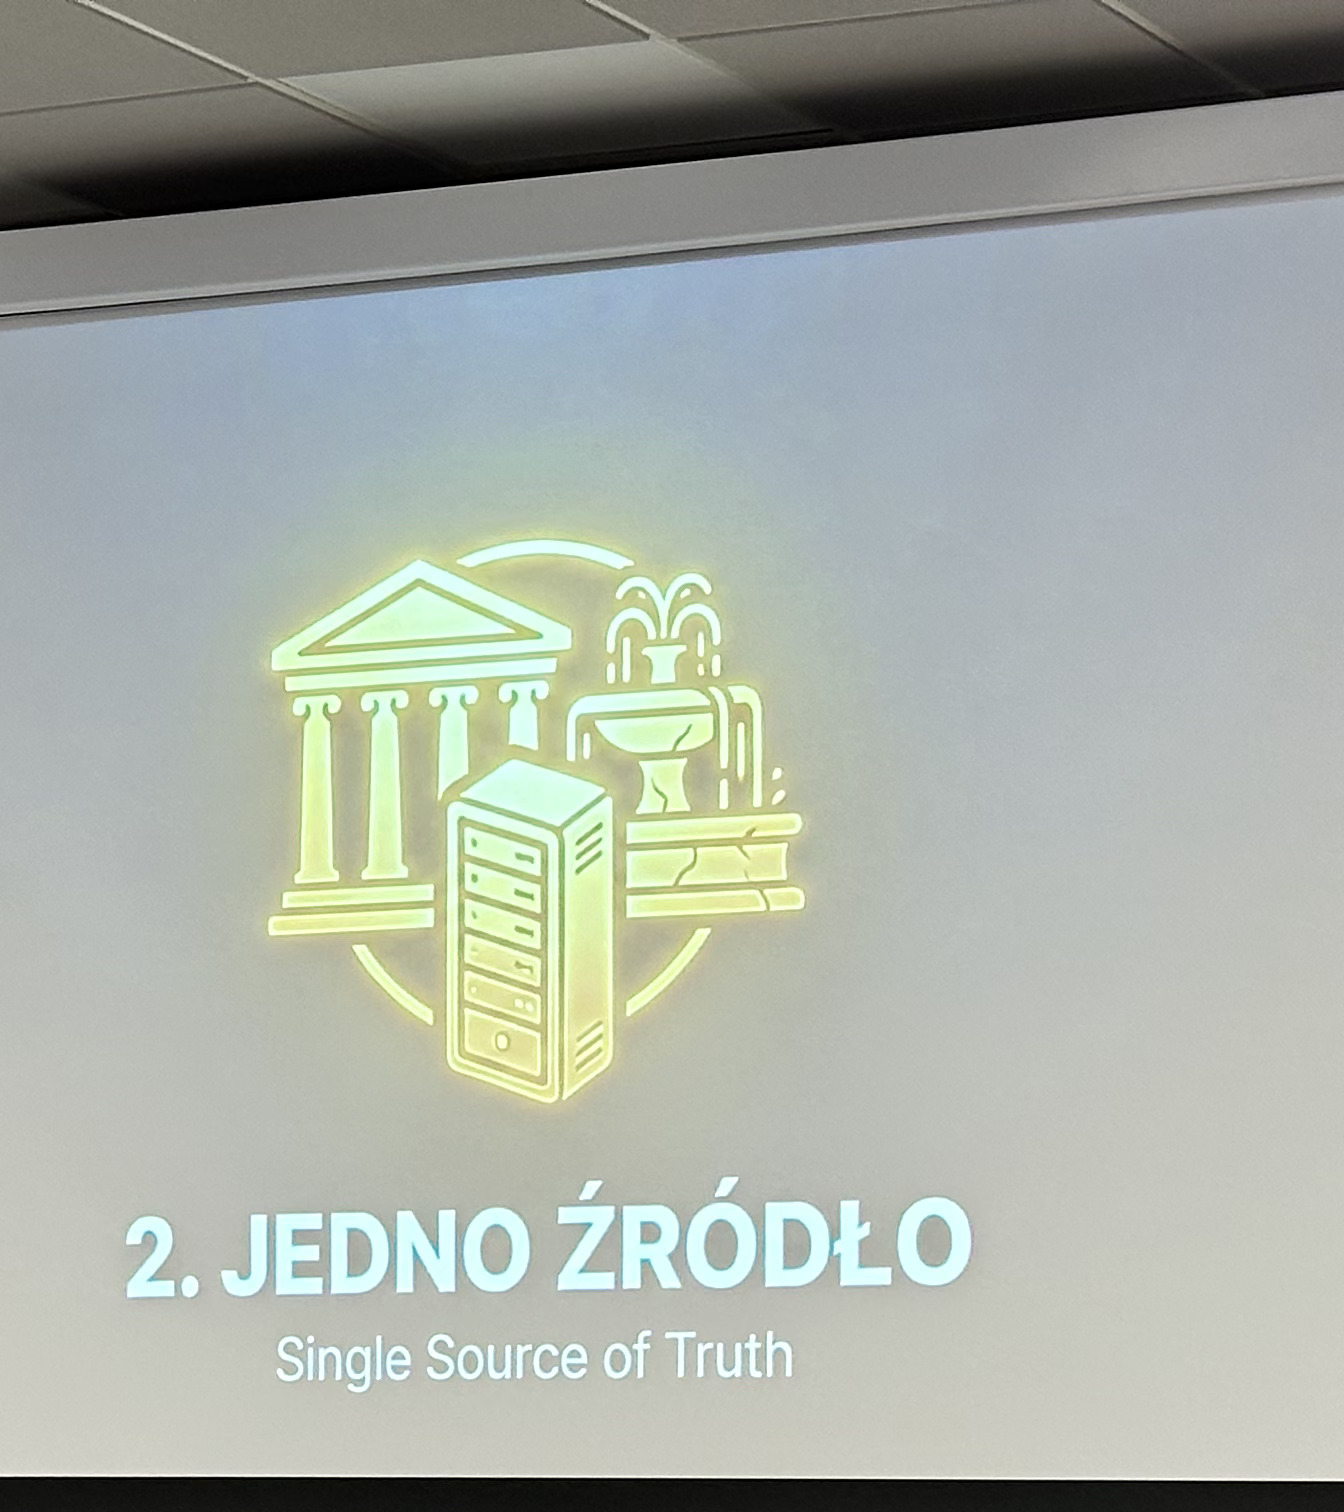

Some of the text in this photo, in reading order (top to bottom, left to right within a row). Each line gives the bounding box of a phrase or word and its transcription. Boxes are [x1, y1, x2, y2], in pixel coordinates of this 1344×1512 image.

[125, 1176, 973, 1299] 2. JEDNO ŹRÓDŁO
[276, 1329, 794, 1394] Single Source of Truth
